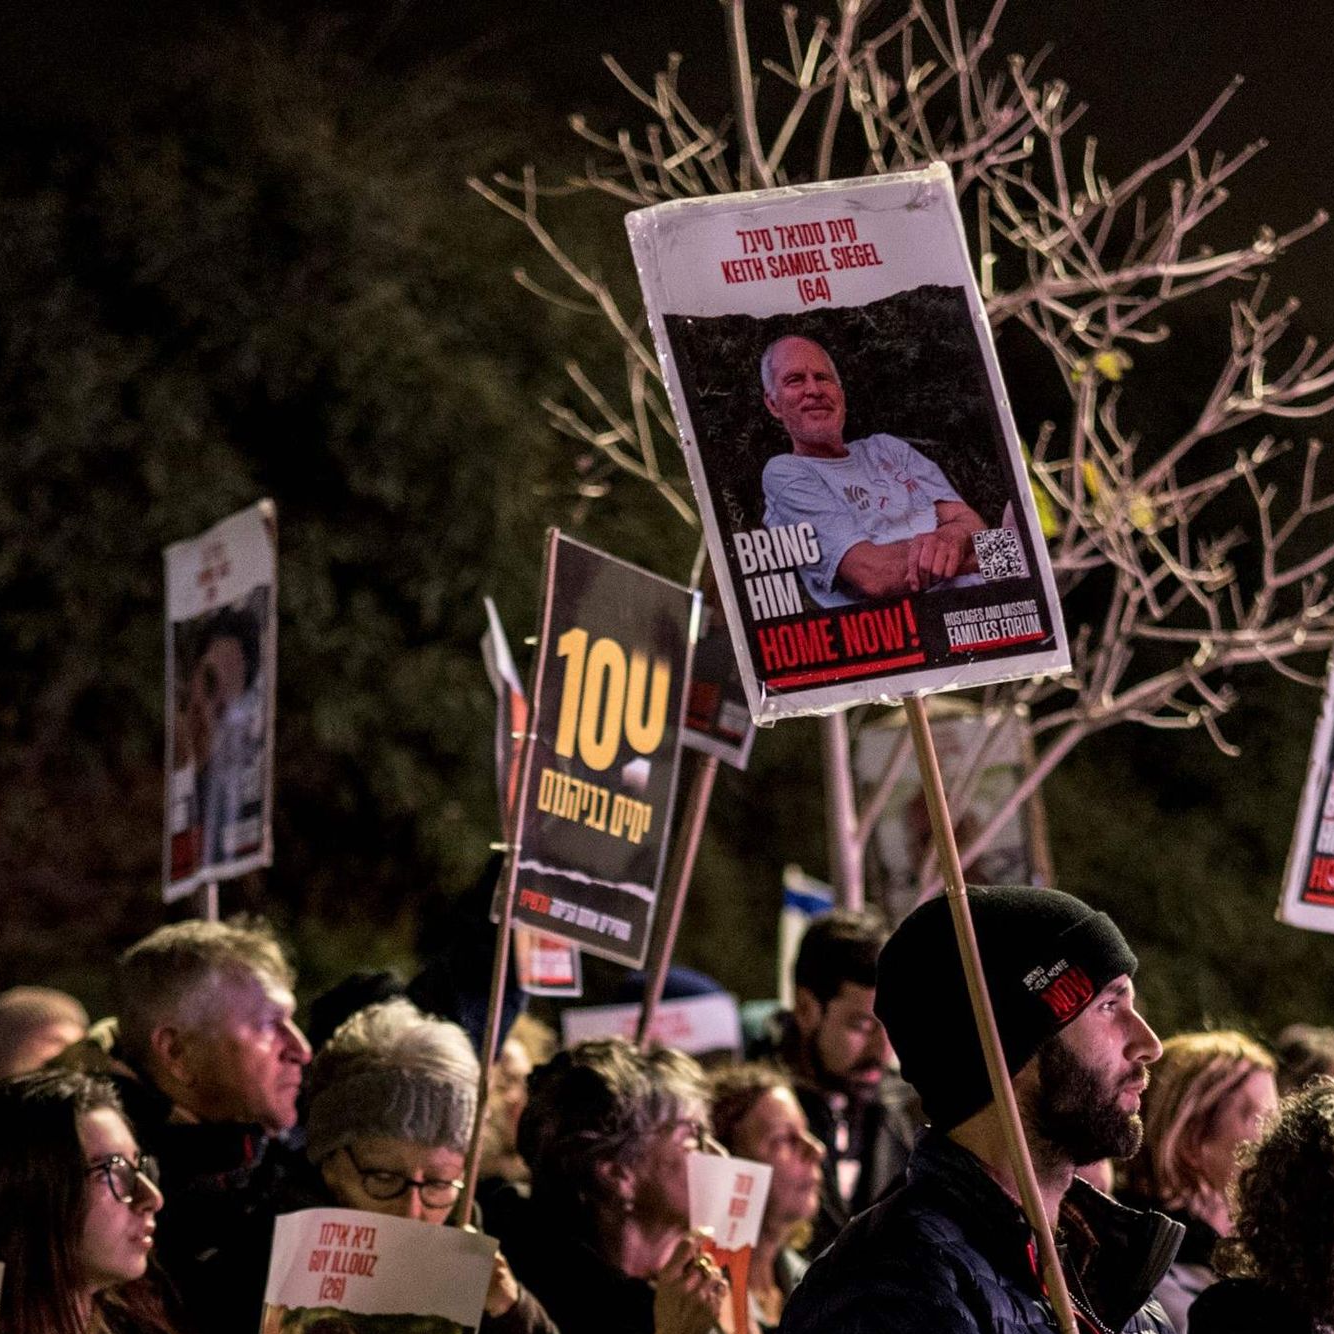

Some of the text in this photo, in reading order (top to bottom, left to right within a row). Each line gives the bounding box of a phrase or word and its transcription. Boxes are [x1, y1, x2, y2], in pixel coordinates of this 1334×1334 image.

[736, 218, 857, 254] קית סמואל סיגל
[721, 243, 883, 284] KEITH SAMUEL SIEGEL
[797, 276, 832, 305] (64)
[733, 522, 820, 575] BRING
[745, 571, 803, 621] HIM
[943, 599, 1038, 626] HOSTAGES AND MISSING
[757, 599, 920, 671] HOME NOW!
[947, 614, 1042, 647] FAMILIES FORUM
[330, 1250, 378, 1278] ILLOUZ
[318, 1274, 347, 1303] (26)
